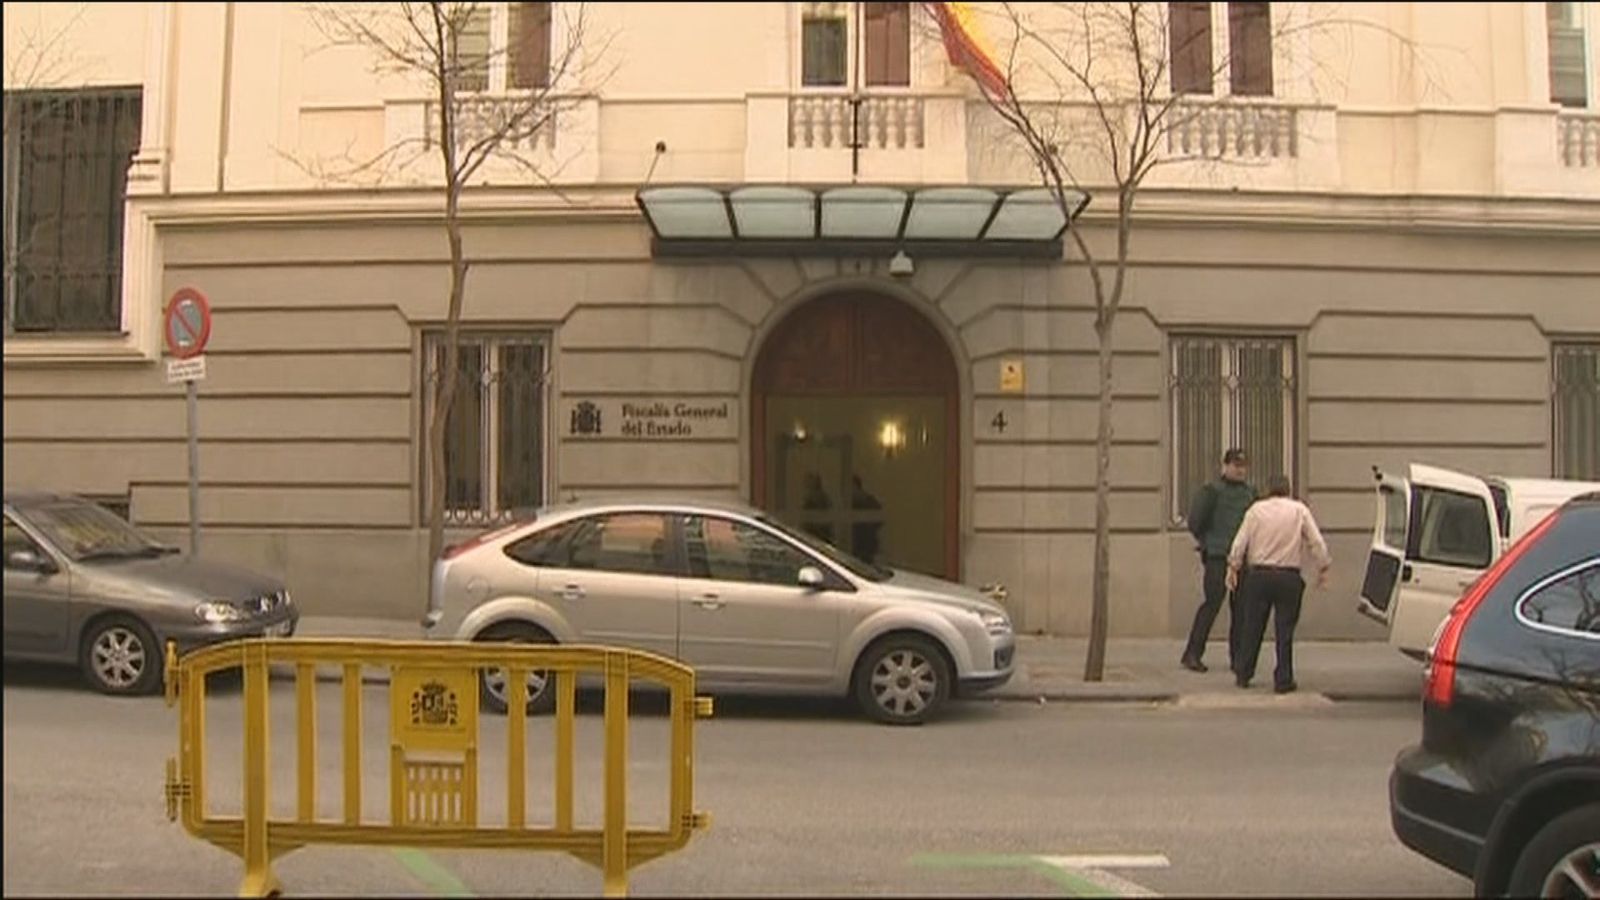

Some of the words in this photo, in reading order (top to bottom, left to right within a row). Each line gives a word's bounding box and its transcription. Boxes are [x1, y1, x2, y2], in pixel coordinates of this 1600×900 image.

[674, 403, 728, 418] General
[621, 421, 642, 436] del
[647, 421, 692, 436] Estado
[991, 410, 1008, 433] 4
